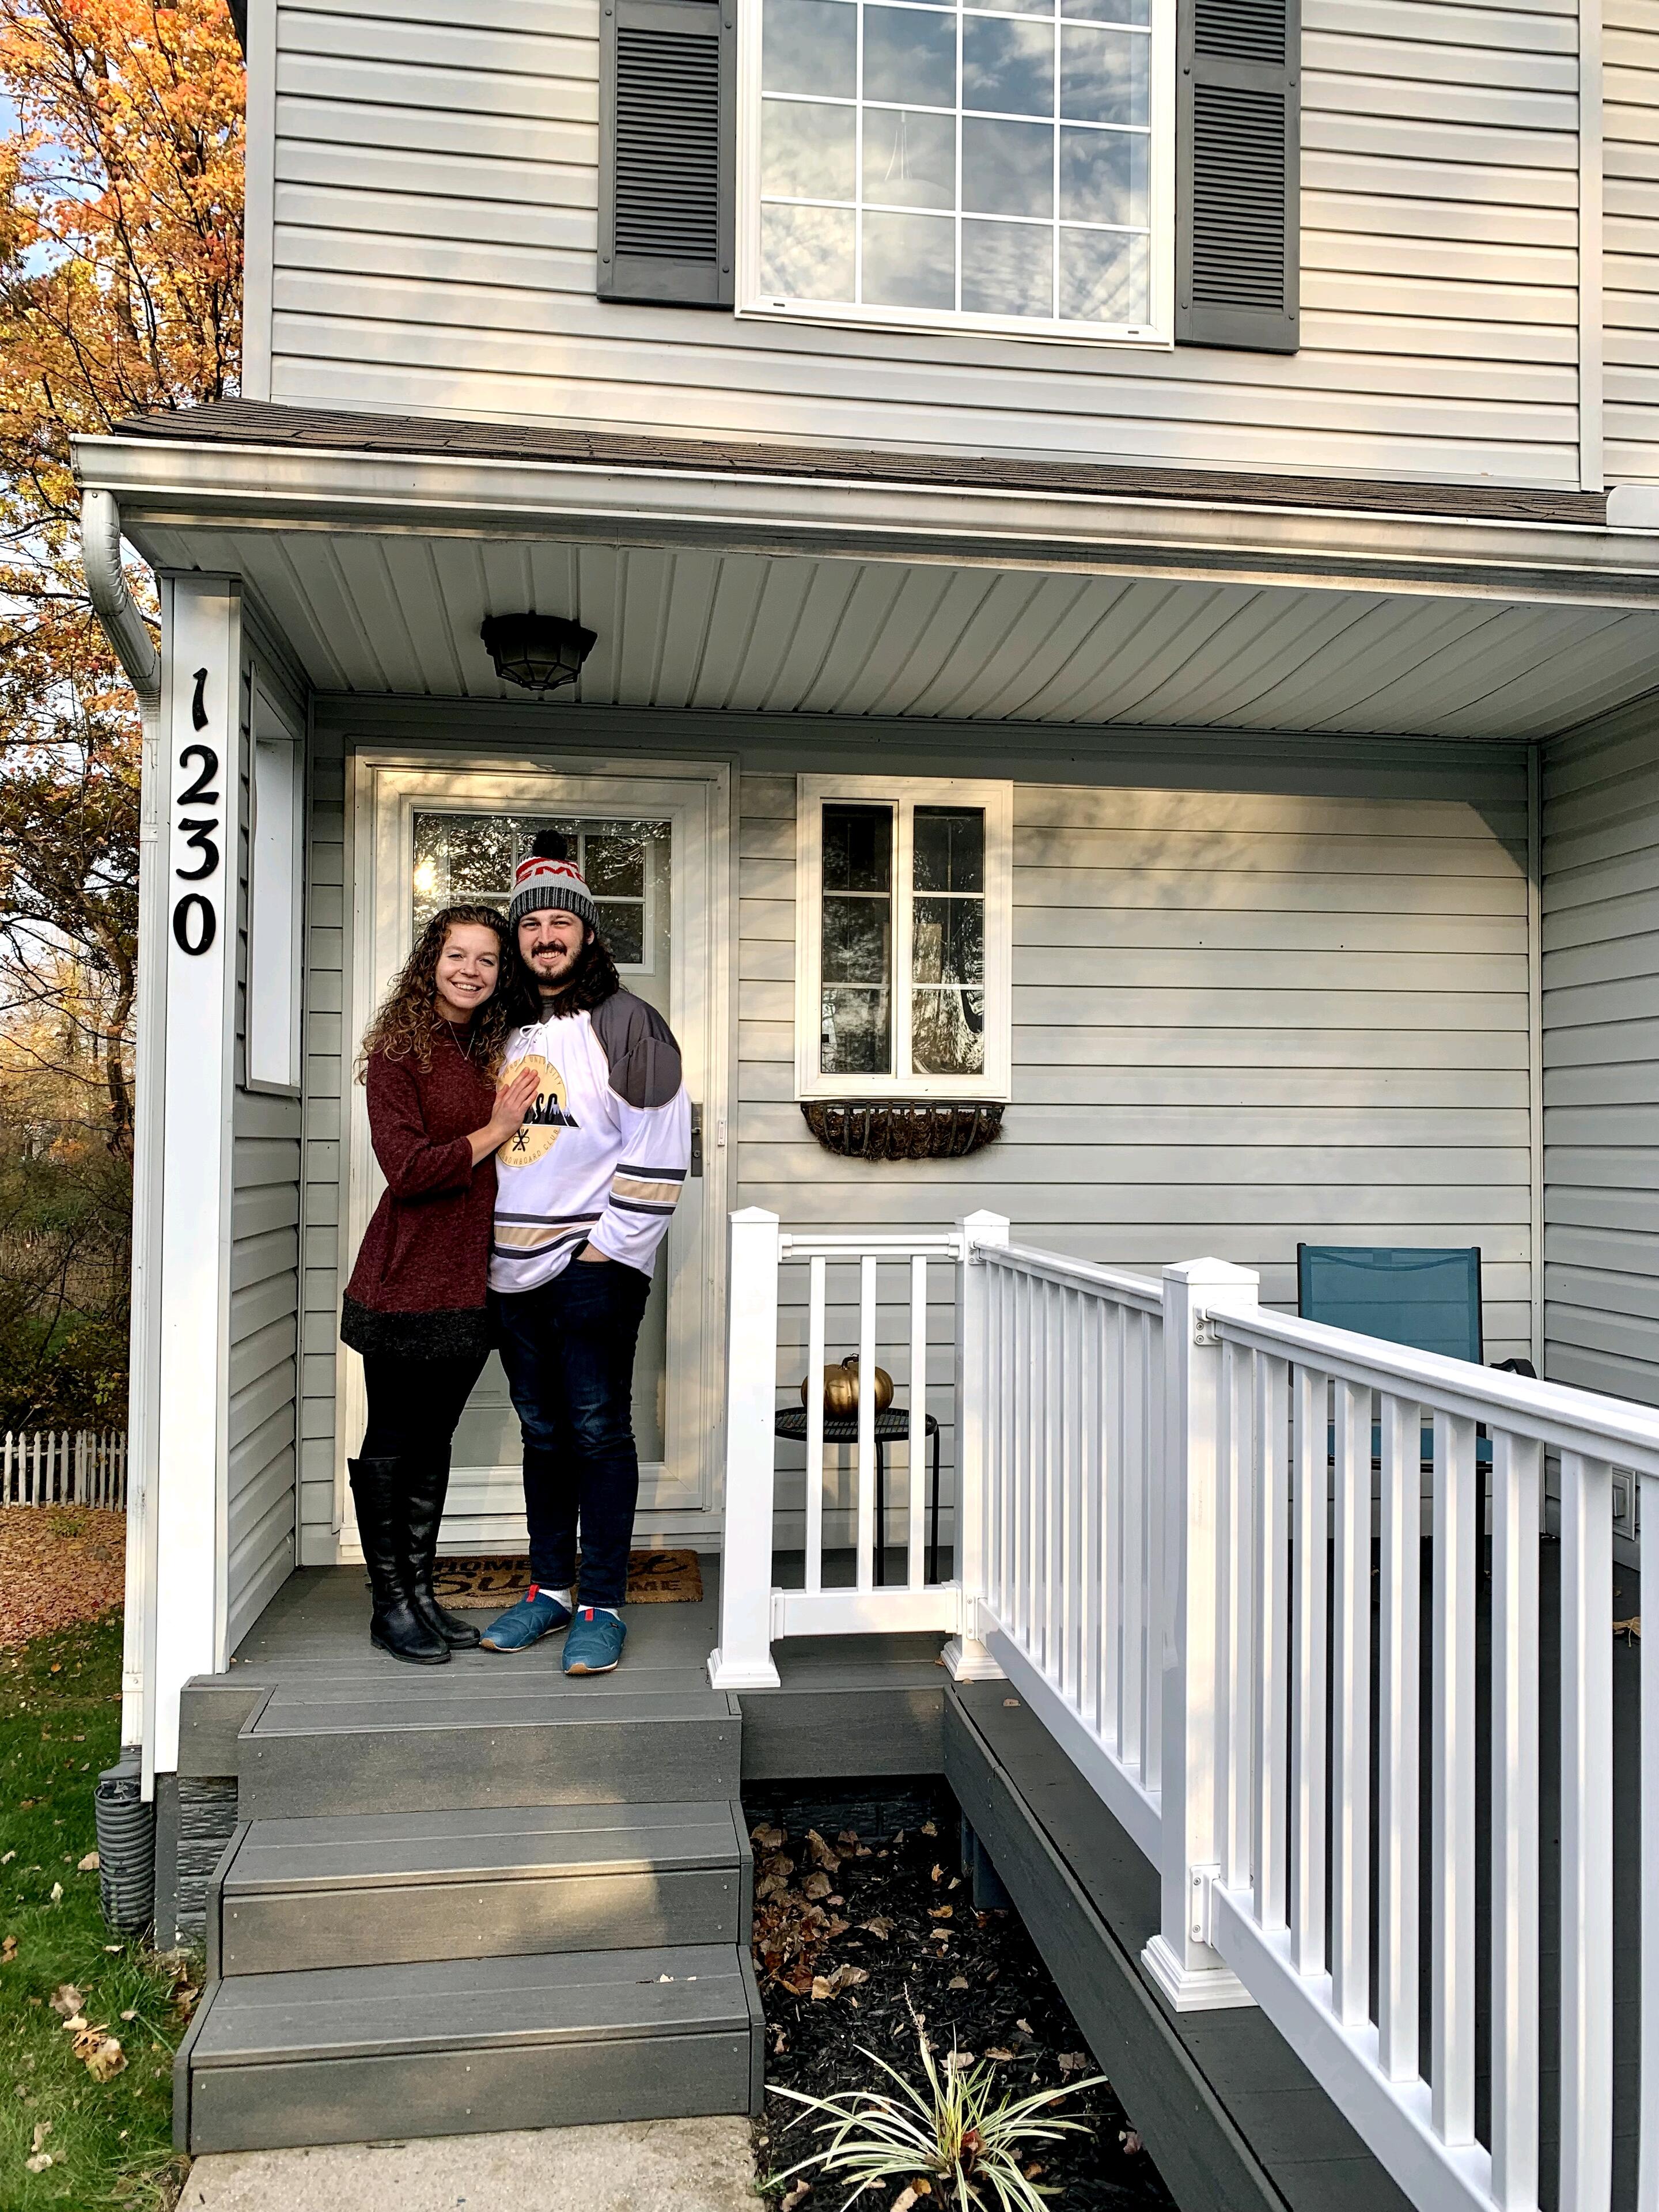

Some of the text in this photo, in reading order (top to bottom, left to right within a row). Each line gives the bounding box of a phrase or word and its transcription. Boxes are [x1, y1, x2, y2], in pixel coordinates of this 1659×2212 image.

[173, 667, 219, 956] 1230
[501, 1055, 562, 1085] PURDE UNIVRSITY
[543, 1129, 559, 1150] CLUB
[433, 1559, 532, 1572] HOME
